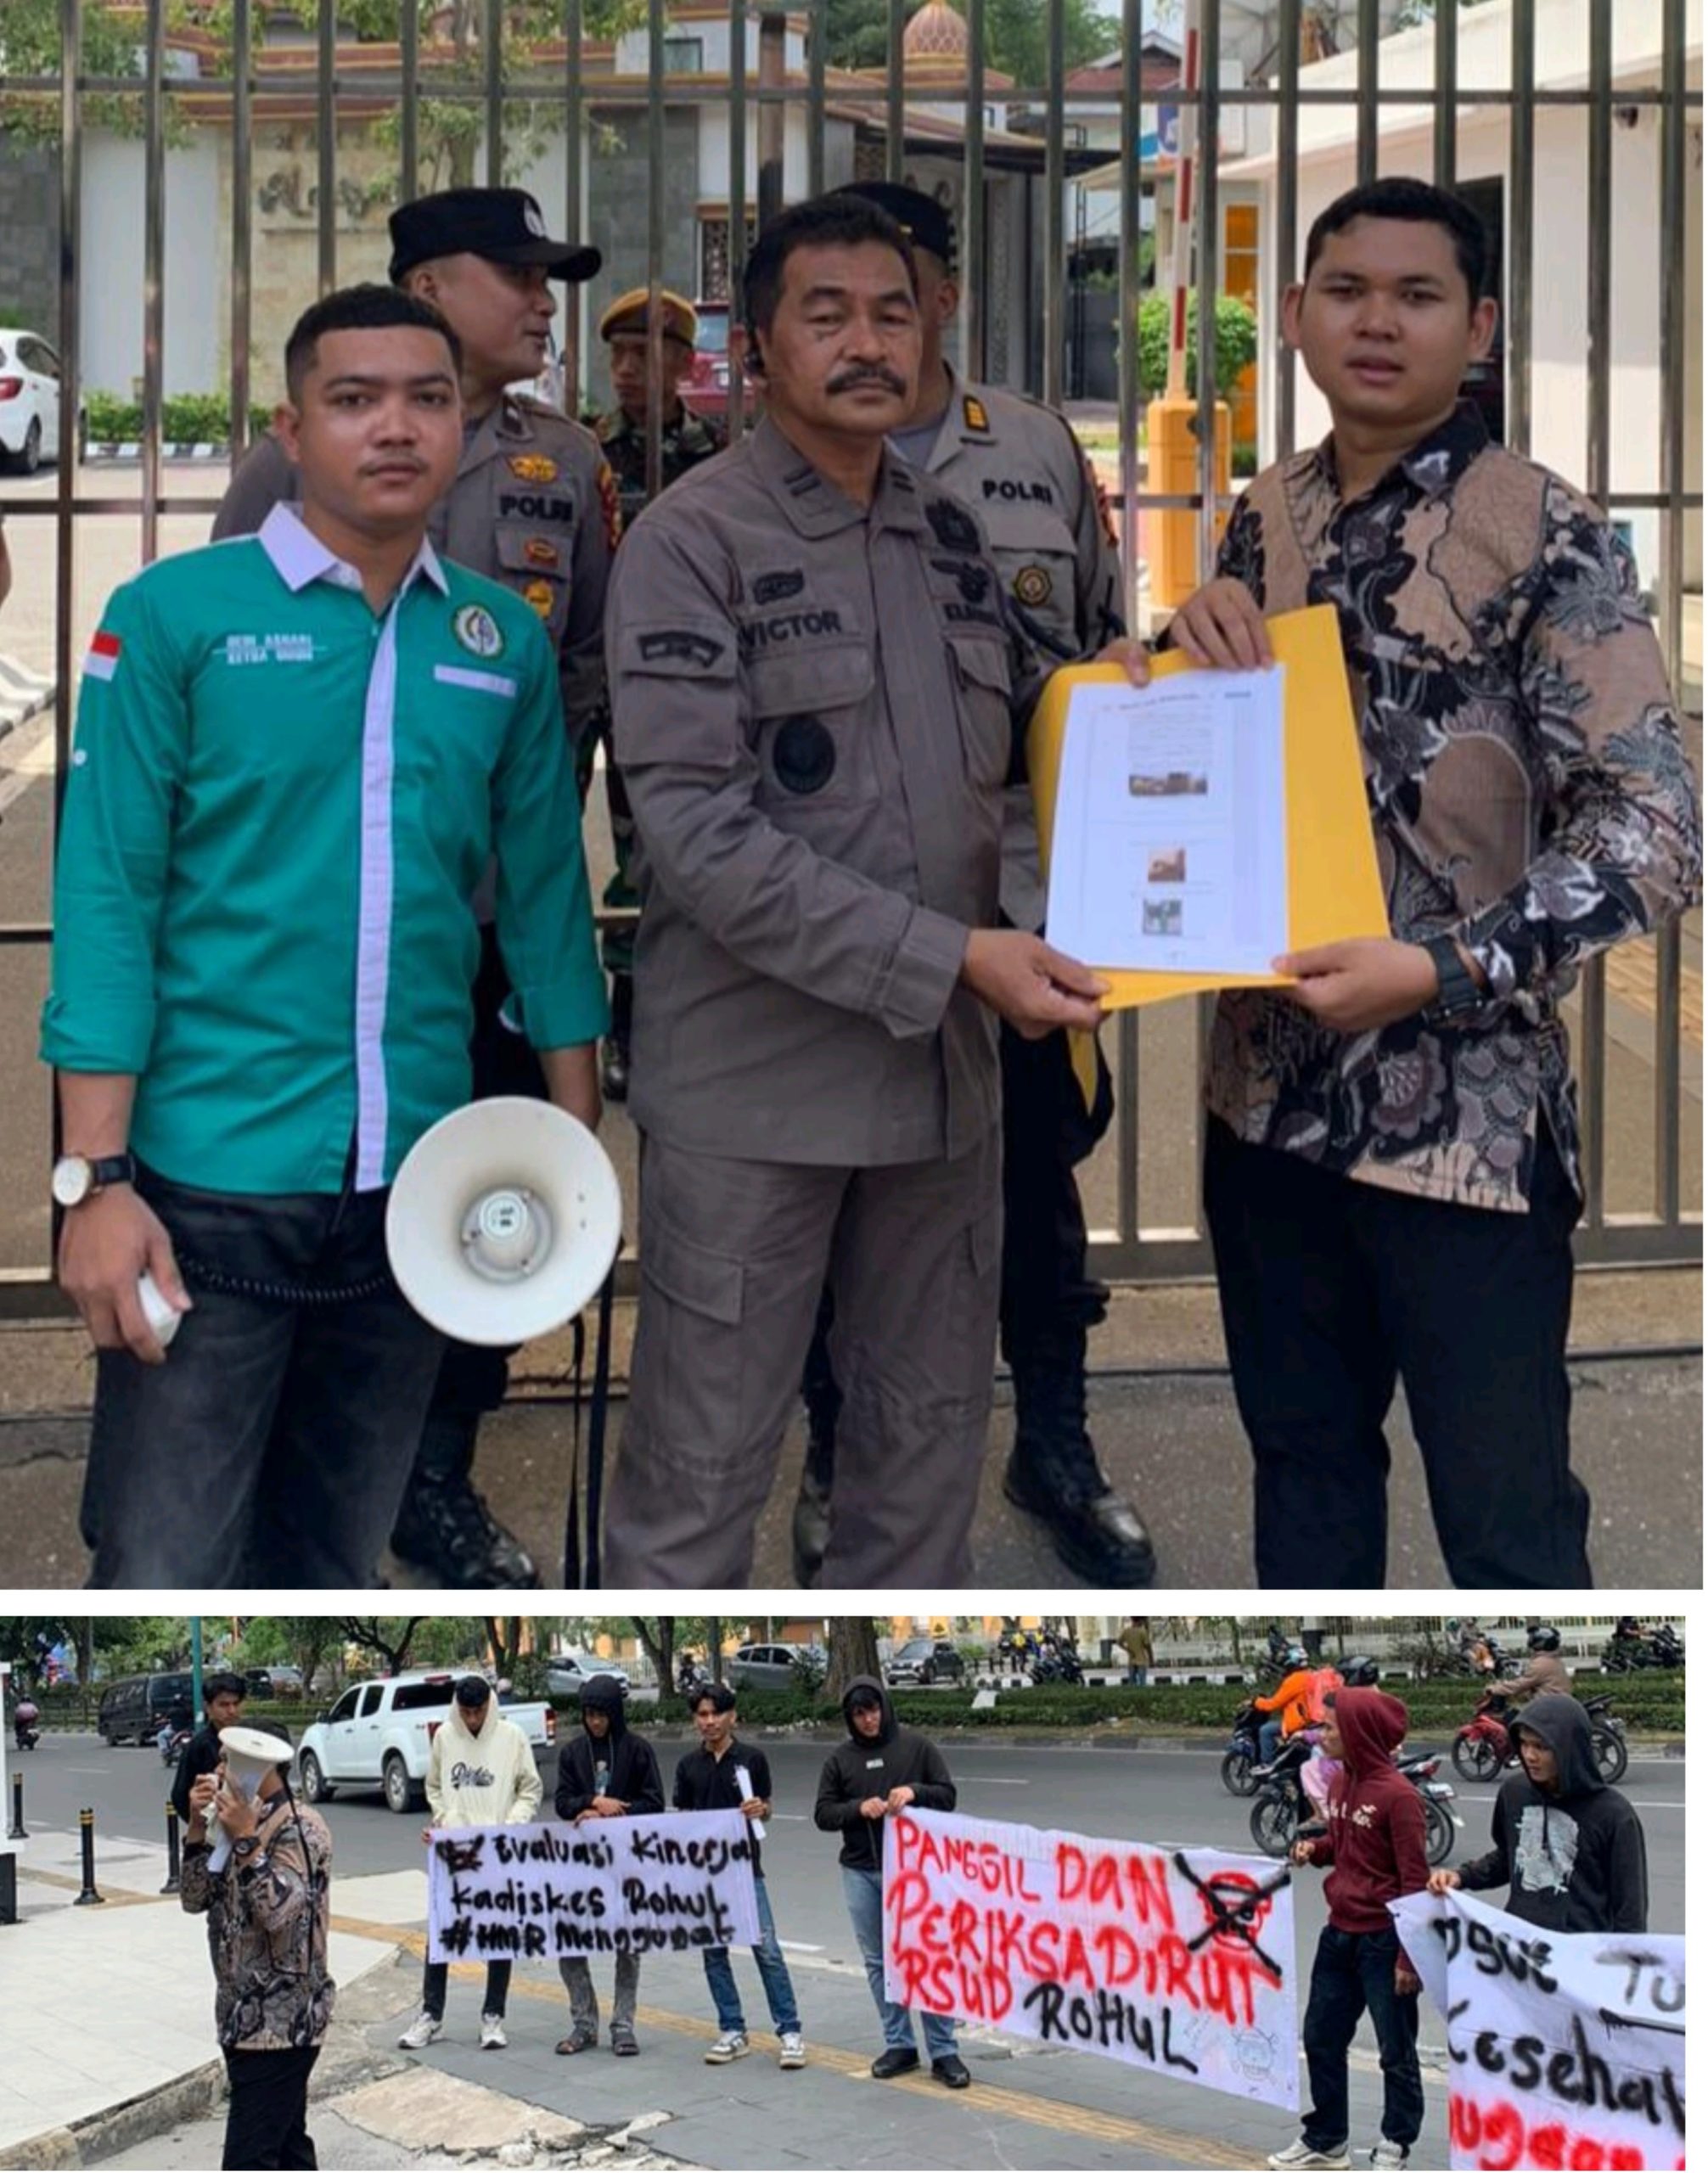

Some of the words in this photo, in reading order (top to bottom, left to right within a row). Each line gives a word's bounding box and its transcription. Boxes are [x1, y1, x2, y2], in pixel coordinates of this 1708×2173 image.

[498, 494, 574, 522] POLRI
[981, 480, 1053, 505] POLRI
[736, 610, 842, 648] VICTOR
[492, 1828, 614, 1868] Evaluasi
[894, 1814, 1041, 1902] PANGGIL
